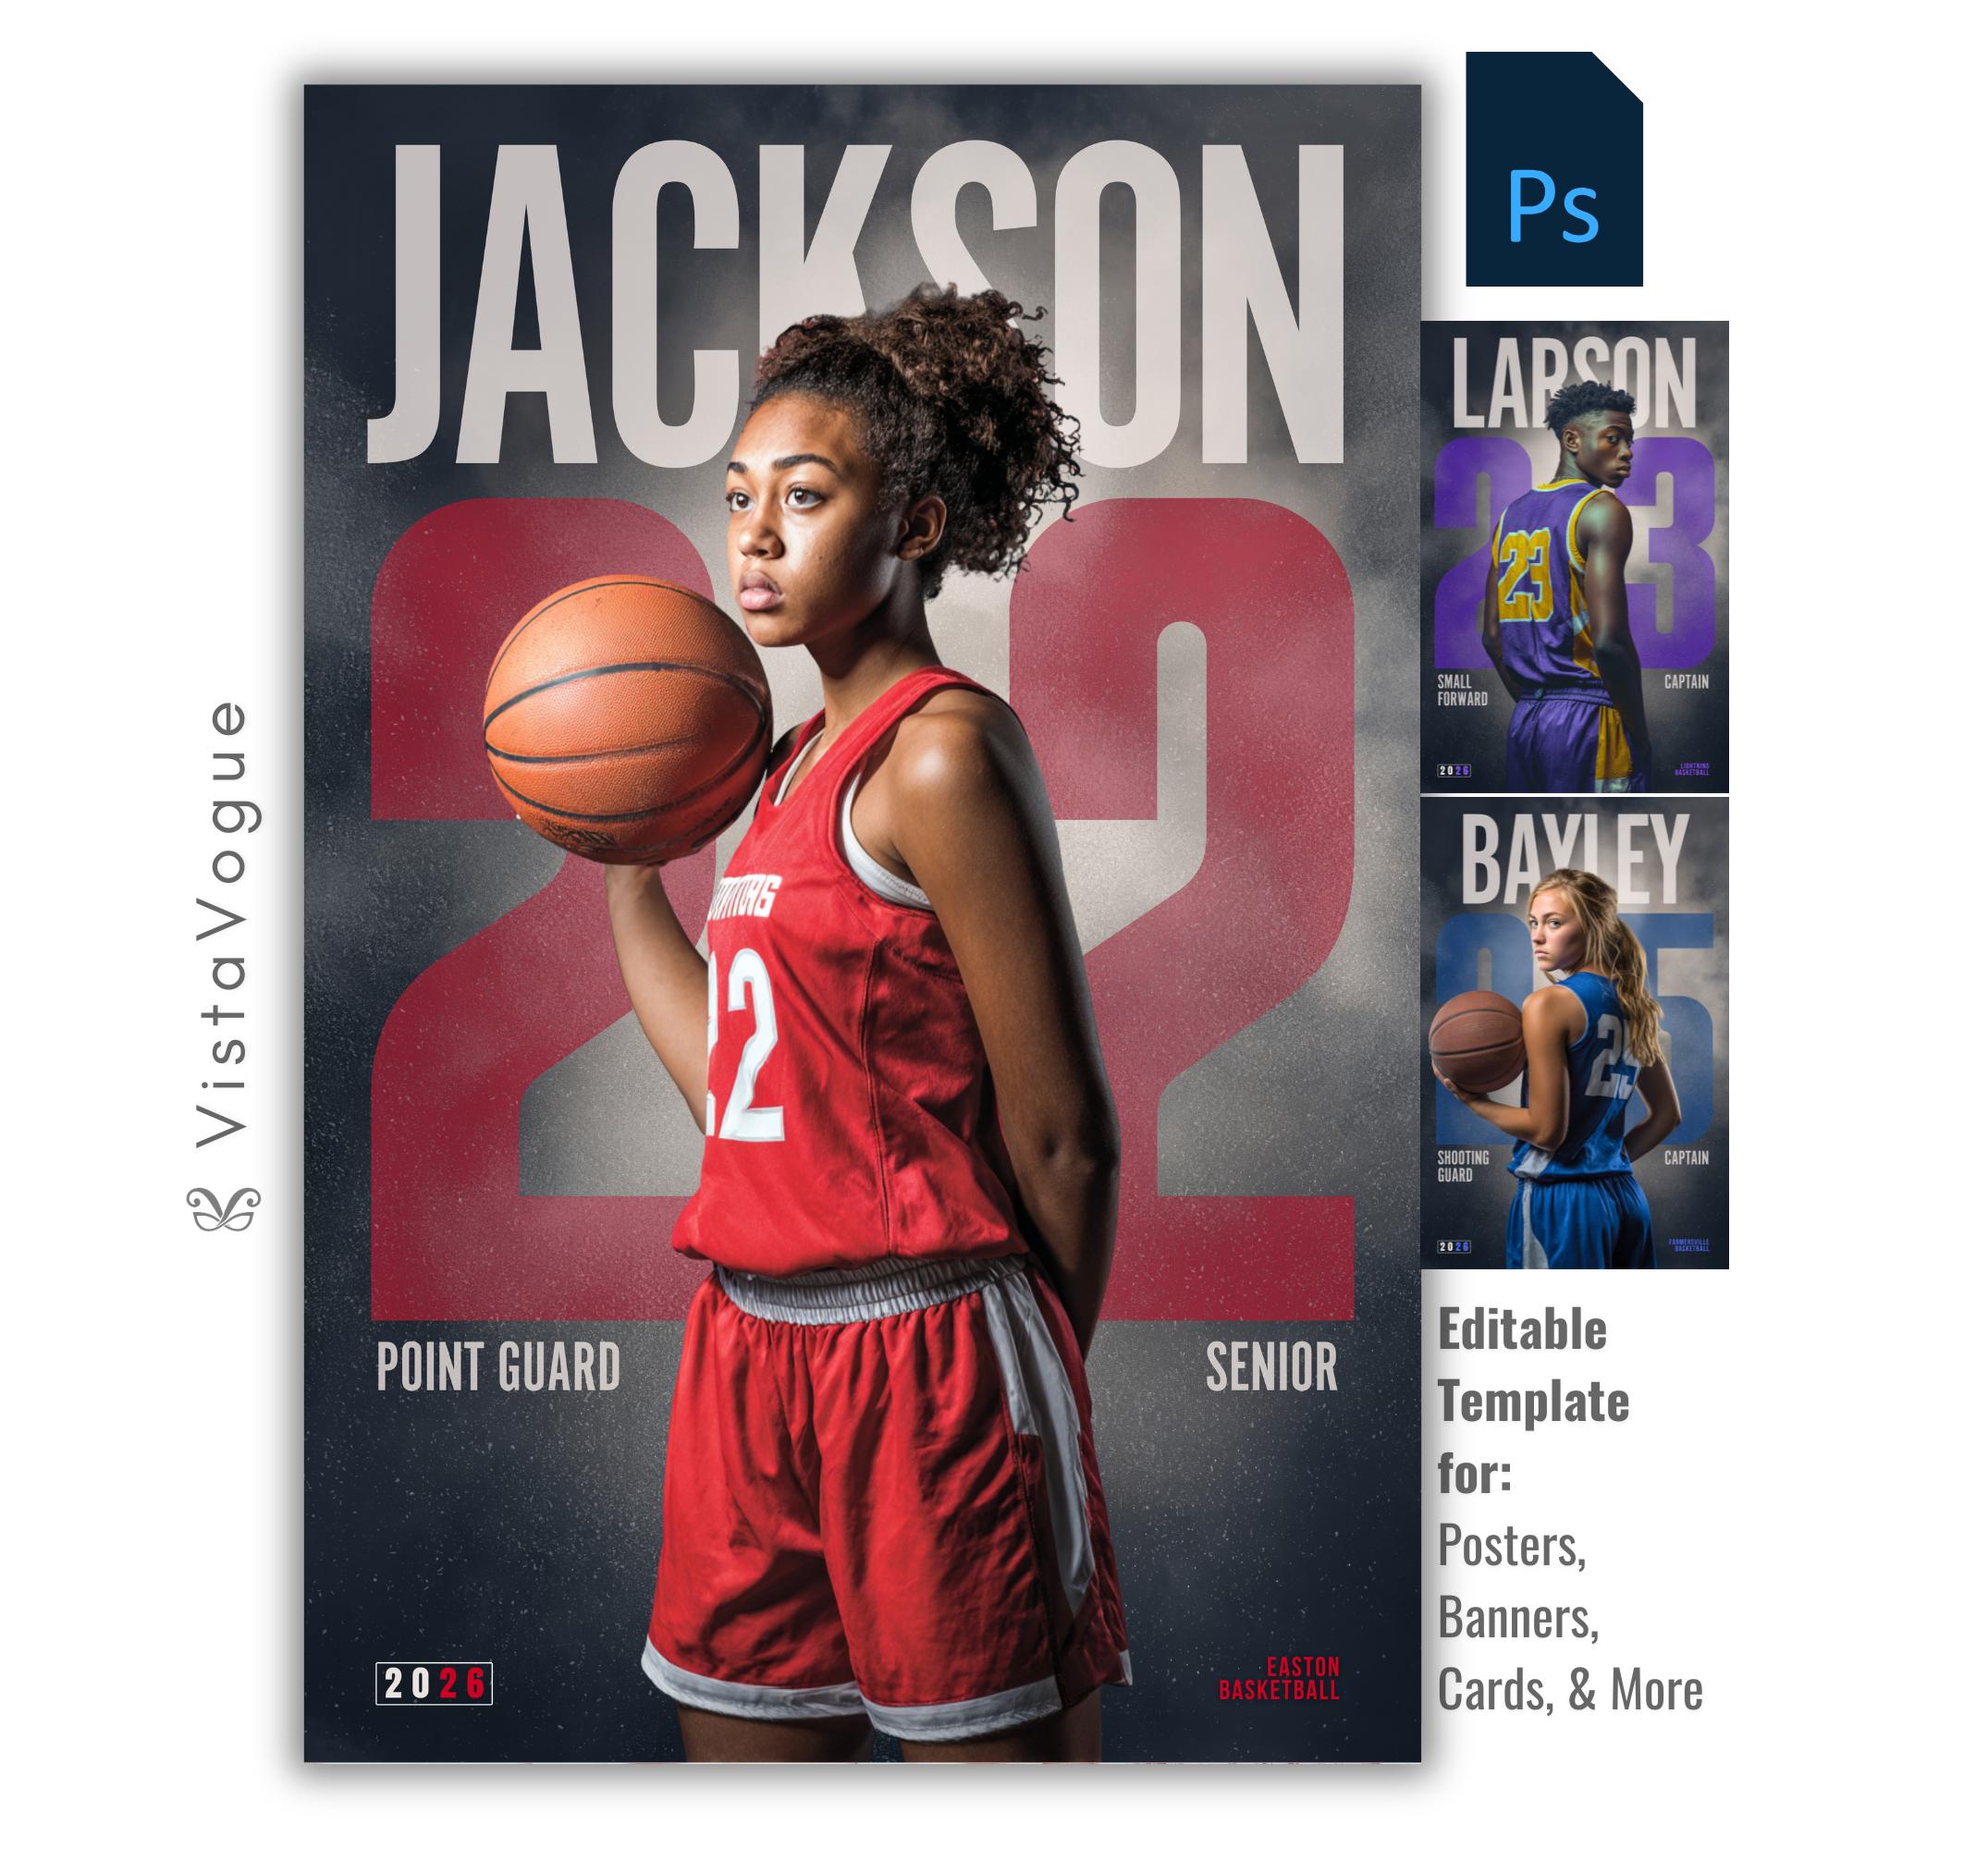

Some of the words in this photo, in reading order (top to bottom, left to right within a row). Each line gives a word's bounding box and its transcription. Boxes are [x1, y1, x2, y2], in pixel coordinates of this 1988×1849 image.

[1510, 169, 1600, 243] Ps
[1497, 527, 1554, 622] 23
[1438, 674, 1472, 689] SMALL
[1664, 674, 1709, 690] CAPTAIN
[1438, 692, 1488, 706] FORWARD
[1440, 766, 1469, 776] 2026
[371, 497, 1355, 1321] 22
[1438, 1150, 1490, 1165] SHOOTING
[1664, 1150, 1709, 1166] CAPTAIN
[1438, 1168, 1473, 1182] GUARD
[1440, 1242, 1469, 1252] 2026
[377, 1341, 485, 1391] POINT
[499, 1341, 620, 1391] GUARD
[1206, 1341, 1338, 1392] SENIOR
[1267, 1656, 1340, 1677] EASTON
[385, 1666, 485, 1699] 2026
[1220, 1679, 1340, 1700] BASKETBALL
